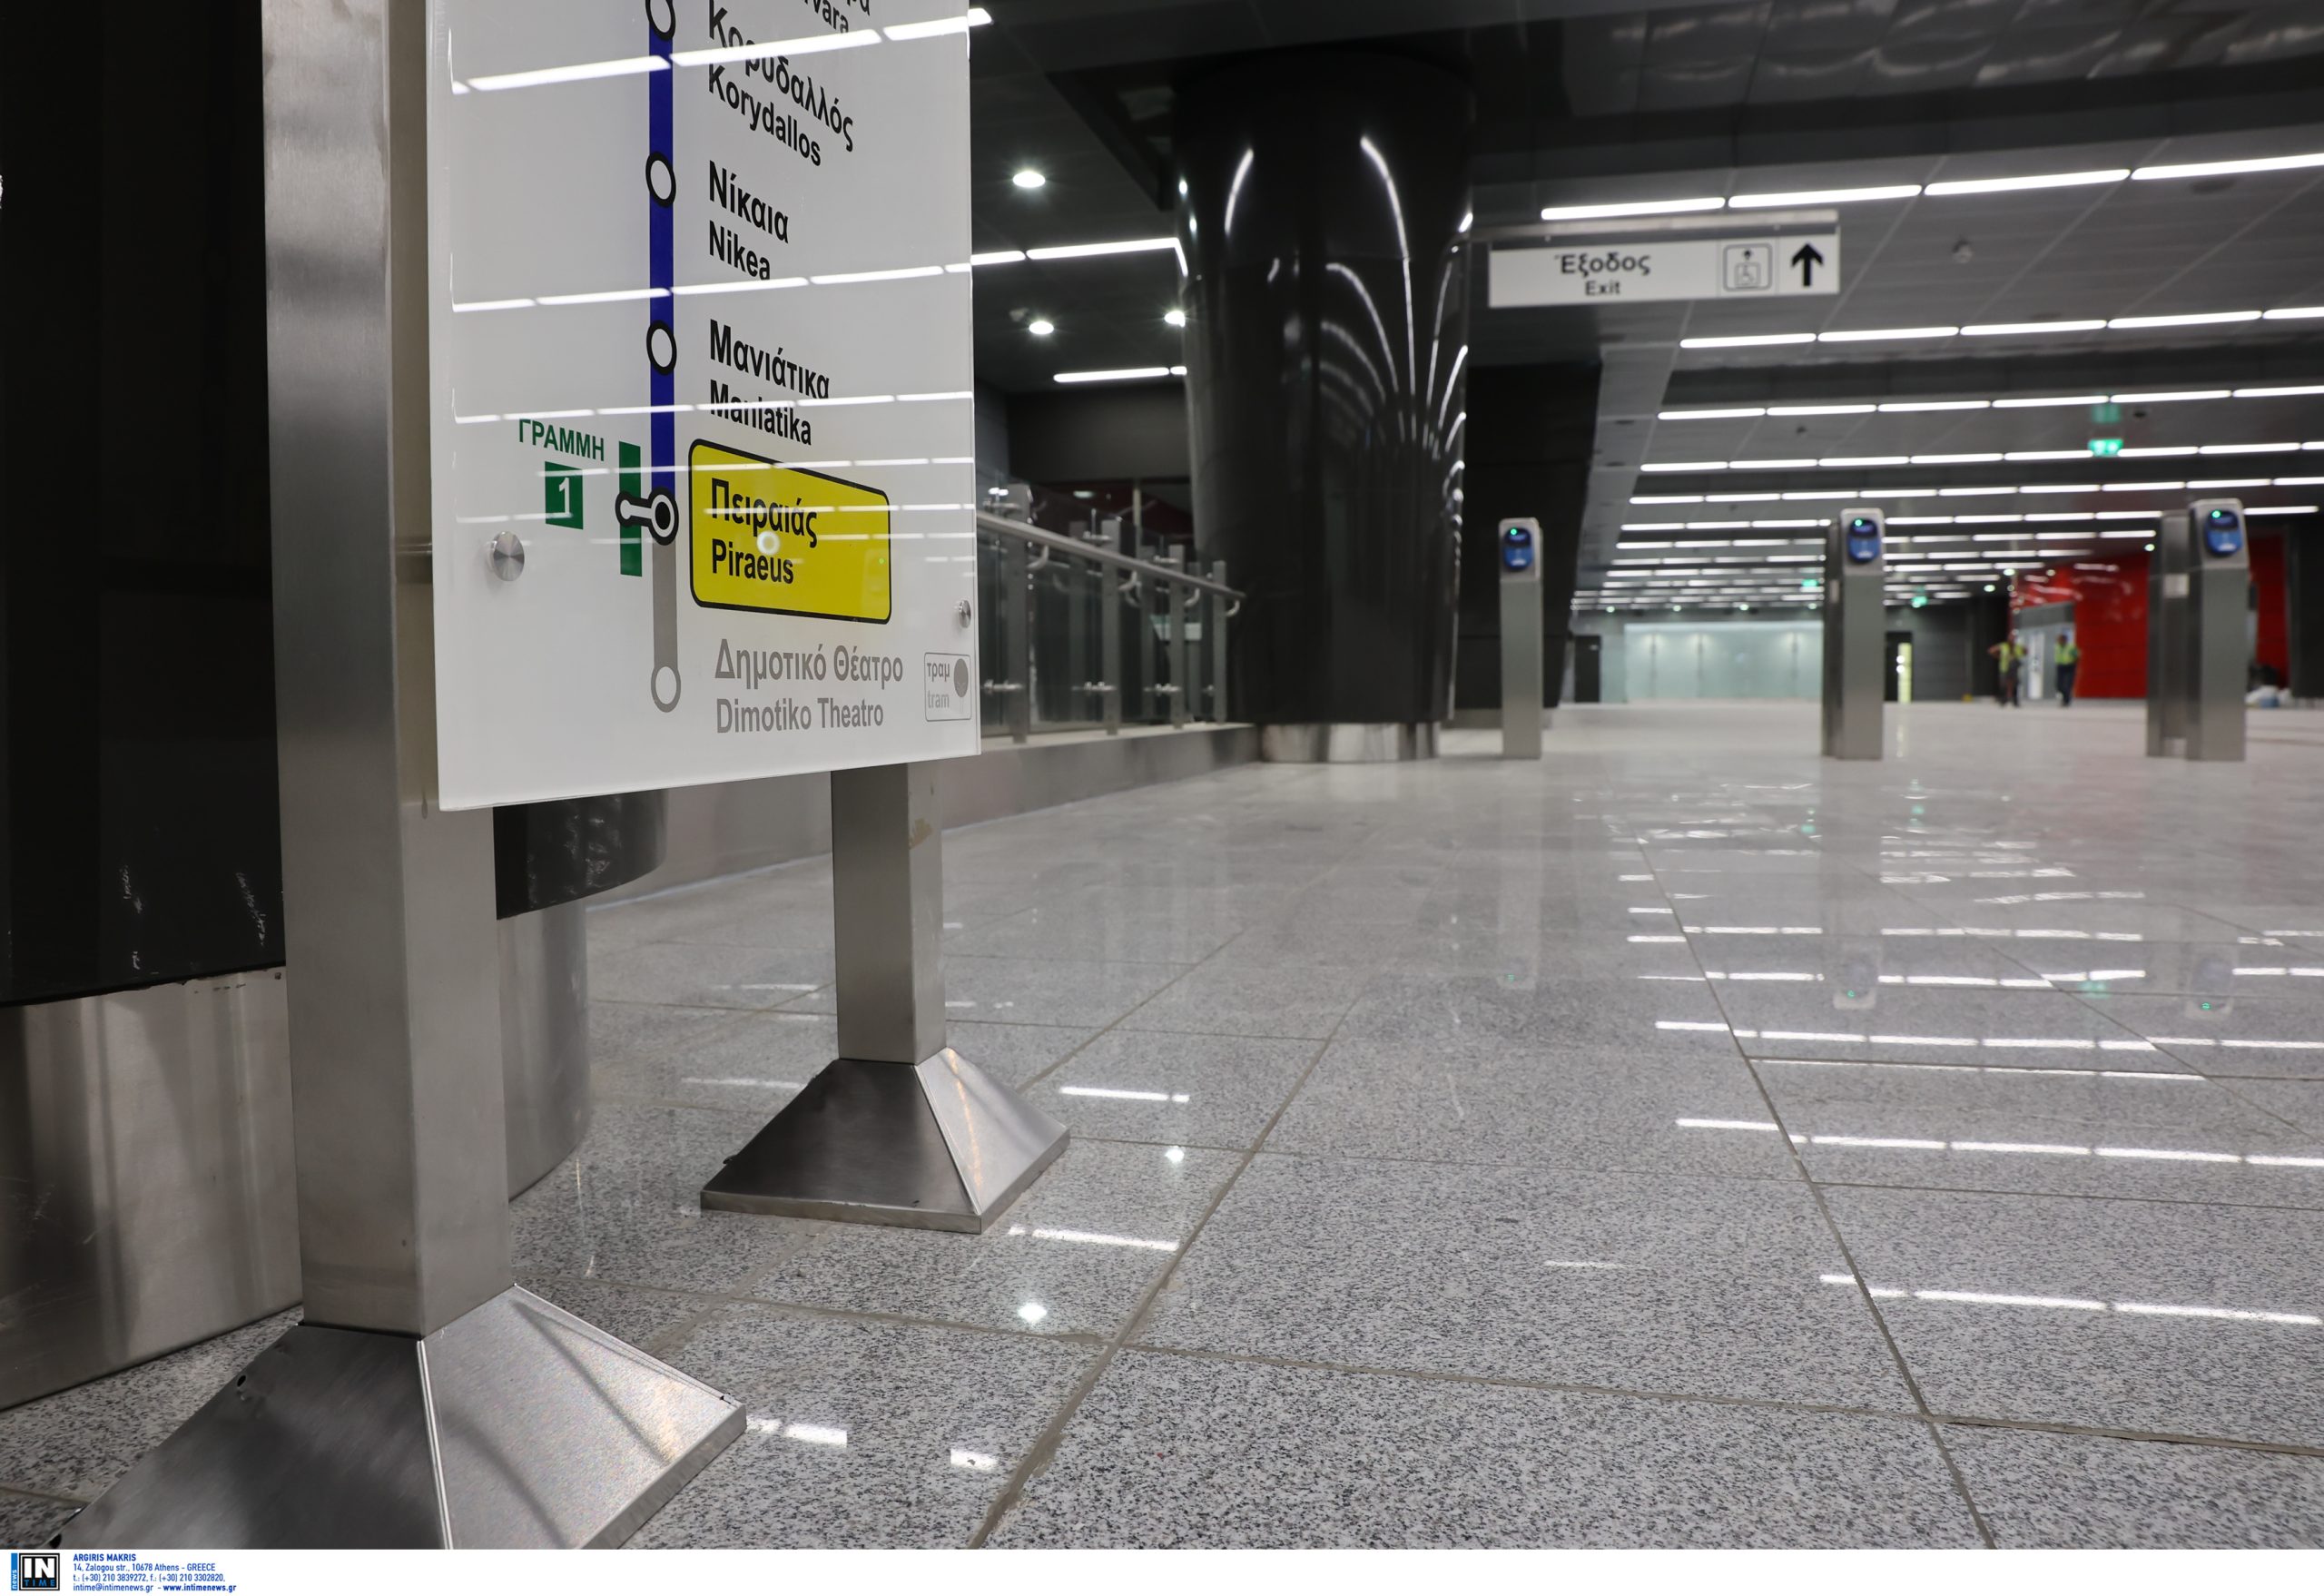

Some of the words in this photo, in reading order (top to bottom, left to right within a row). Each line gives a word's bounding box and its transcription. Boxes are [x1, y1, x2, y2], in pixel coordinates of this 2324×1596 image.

[708, 63, 822, 166] Korydallos
[709, 160, 789, 244] Νίκαια
[709, 221, 771, 281] Nikea
[1553, 252, 1651, 279] Έξοδος
[1584, 281, 1621, 296] Exit
[709, 320, 830, 399] Μανιάτικα
[710, 379, 812, 446] Maniatika
[519, 419, 605, 462] ΓΡΑΜΜΗ
[558, 477, 571, 517] 1
[712, 477, 818, 548] Πειραιάς
[712, 537, 794, 585] Piraeus
[714, 638, 827, 690] Δημοτικό
[833, 645, 903, 690] Θέατρο
[926, 661, 951, 683] τραμ
[715, 697, 812, 734] Dimotiko
[817, 697, 884, 729] Theatro
[927, 689, 950, 709] tram
